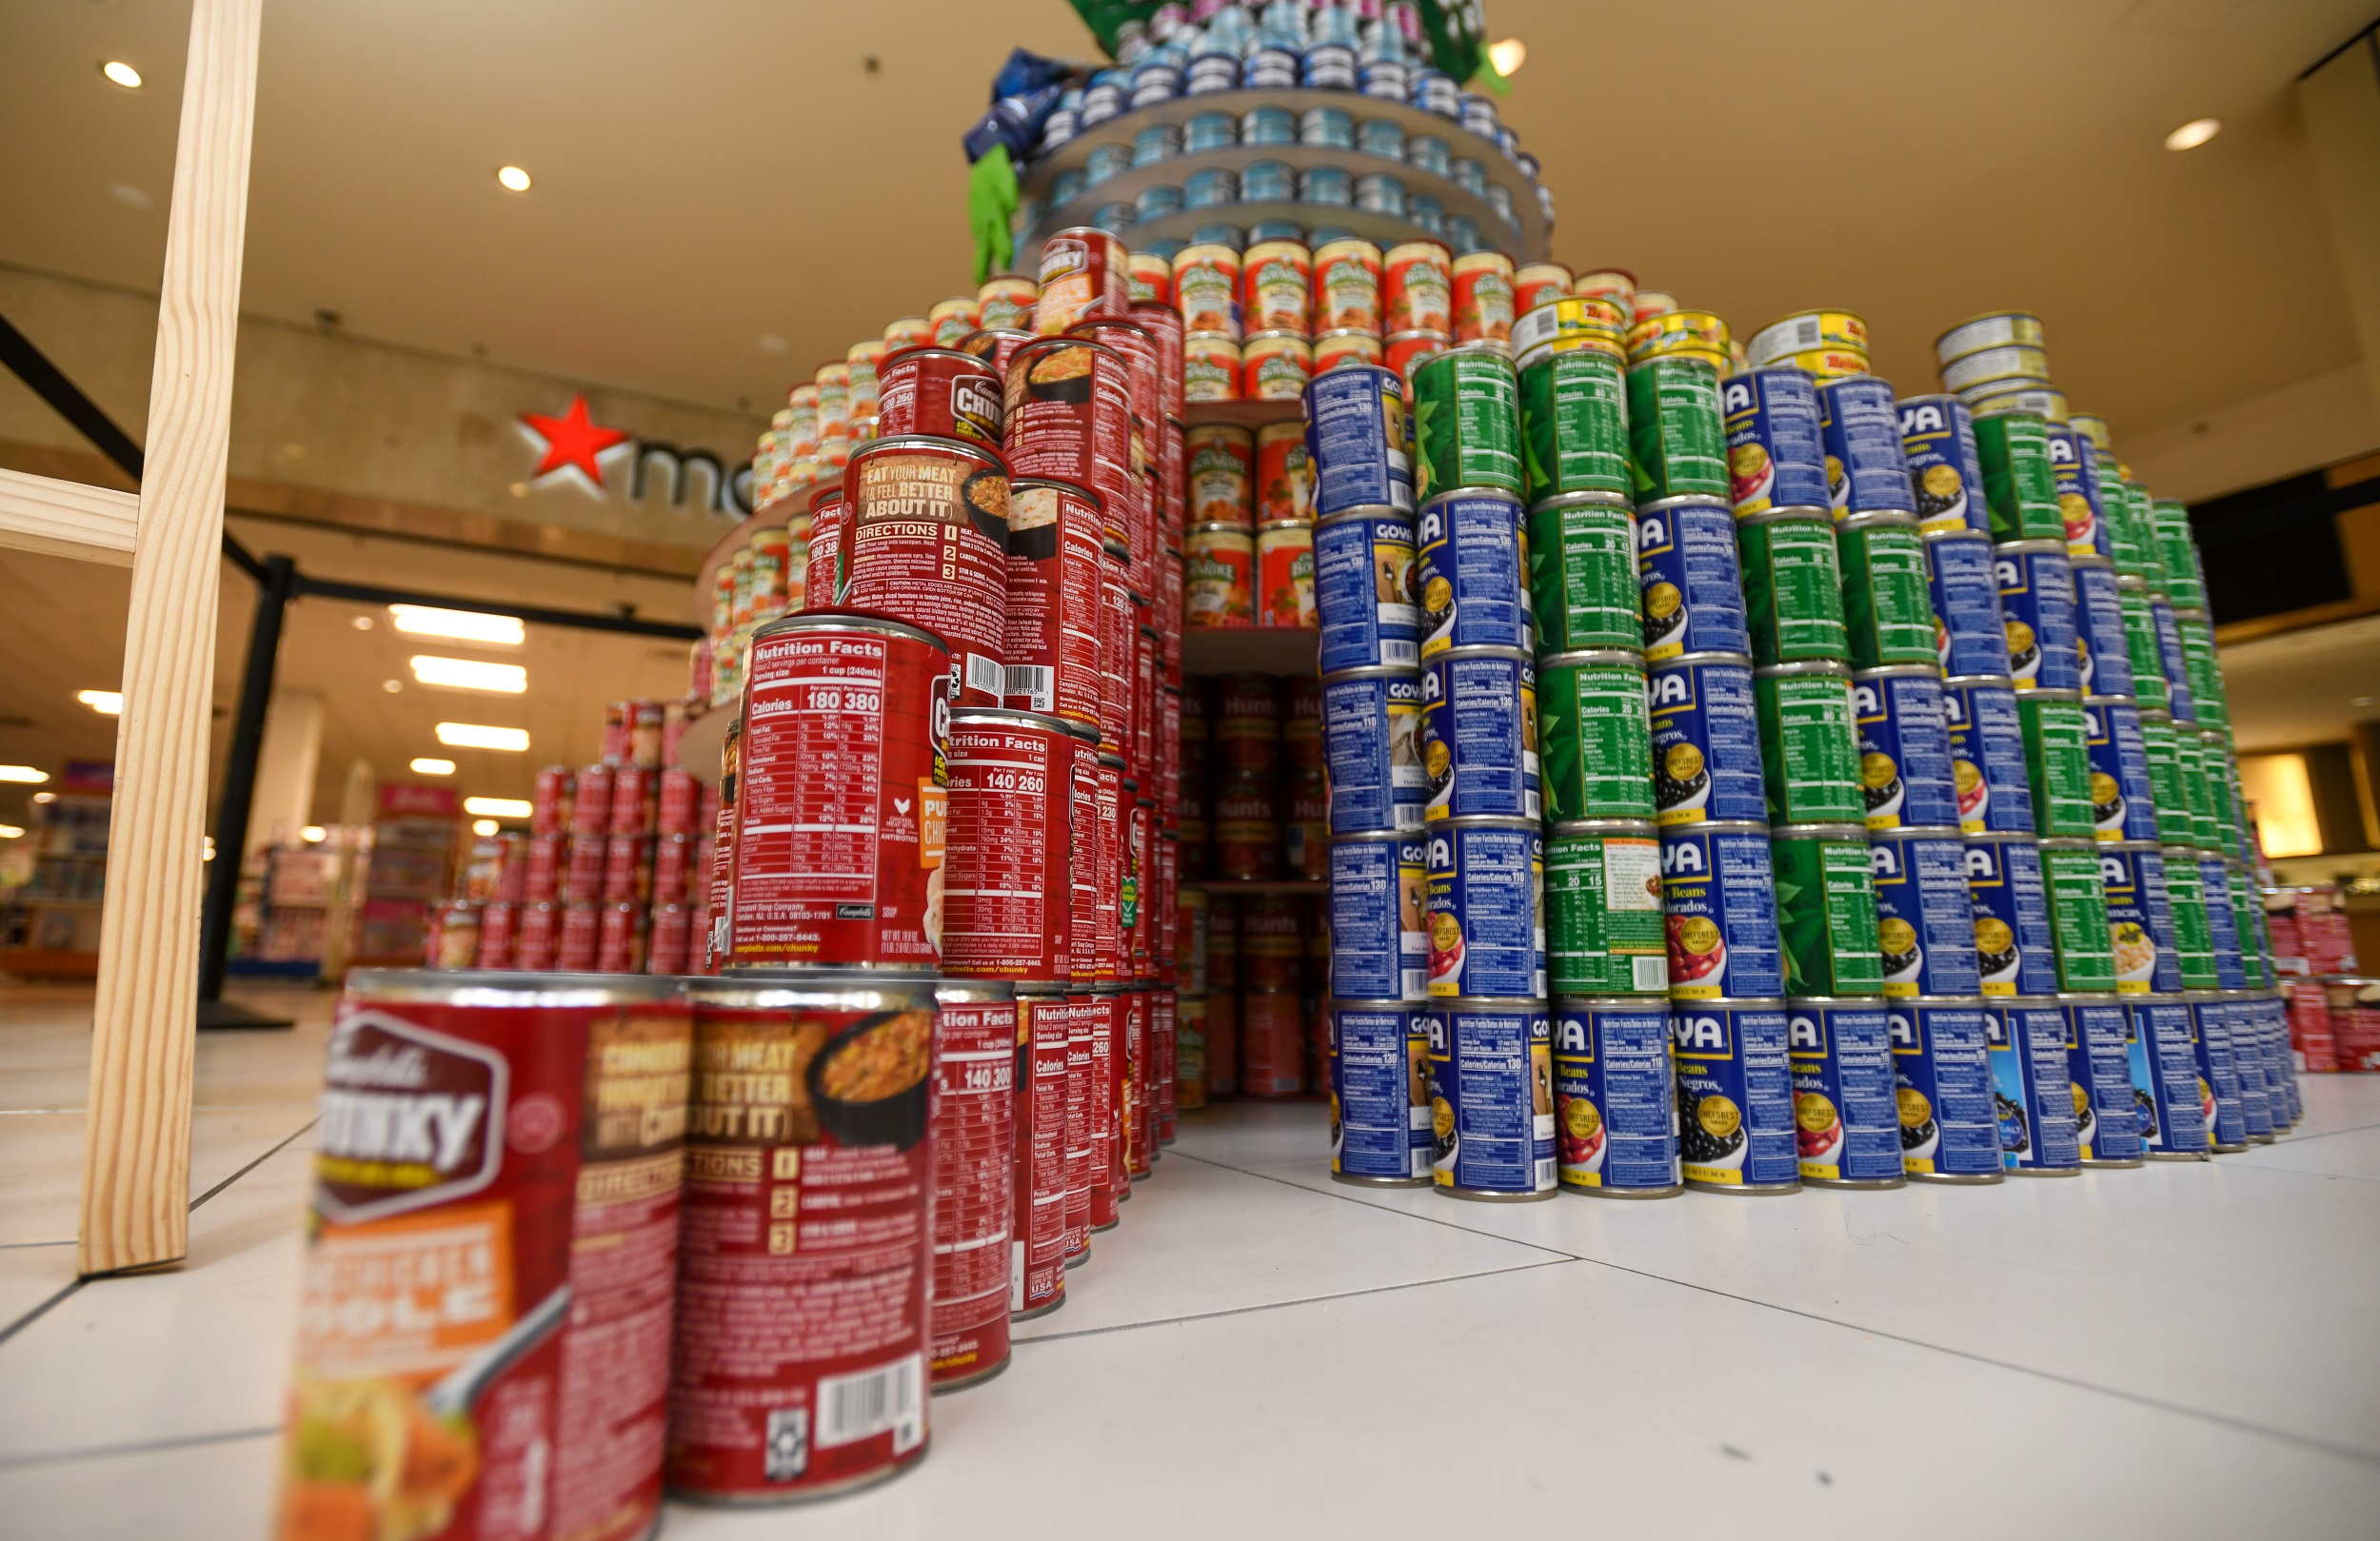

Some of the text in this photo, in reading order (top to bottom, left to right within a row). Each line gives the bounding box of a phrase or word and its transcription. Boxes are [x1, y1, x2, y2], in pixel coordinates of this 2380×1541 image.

[892, 365, 916, 377] Facts
[1557, 361, 1595, 371] Nutrition
[897, 392, 913, 404] 260
[1557, 389, 1584, 398] Calories
[1358, 402, 1372, 412] 130
[866, 465, 956, 485] EAT YOUR MEAT
[877, 483, 953, 500] FEEL BETTER
[865, 500, 953, 520] ABOUT IT)
[1564, 510, 1628, 521] Nutrition Facts
[856, 525, 938, 541] DIRECTIONS
[1377, 524, 1413, 542] GOYA
[1772, 525, 1812, 534] Nutrition
[1500, 535, 1512, 545] 130
[1565, 541, 1593, 550] Calories
[1605, 539, 1616, 548] 20
[1064, 541, 1094, 559] Calories
[1351, 557, 1364, 567] 130
[1774, 556, 1802, 564] Calories
[756, 641, 883, 662] Nutrition Facts
[772, 656, 840, 667] servings per container
[754, 672, 774, 682] Serving
[829, 667, 844, 677] cup
[847, 666, 881, 678] (240mL)
[1624, 674, 1642, 682] Facts
[1390, 682, 1425, 700] GOY
[1650, 673, 1688, 706] YA
[751, 692, 879, 716] Calories 180 380
[1499, 697, 1513, 707] 130
[1623, 704, 1632, 714] 20
[1782, 712, 1835, 723] Calories 80
[949, 735, 1045, 753] trition Facts
[987, 774, 1043, 793] 140 260
[1102, 806, 1116, 820] 230
[881, 834, 918, 843] ANTIBIOTICS
[1572, 843, 1601, 853] Facts
[1661, 842, 1702, 874] YA
[1513, 872, 1524, 882] 110
[1568, 876, 1602, 887] 20 15
[1371, 880, 1387, 891] 130
[1672, 886, 1706, 898] Beans
[1430, 897, 1452, 910] rados
[2107, 896, 2134, 905] eans
[758, 903, 772, 912] Soup
[774, 903, 803, 912] Company
[882, 907, 897, 919] SOUP
[1666, 900, 1707, 914] lorados
[789, 912, 830, 920] 08103-1701
[735, 944, 818, 954] campbells.com/chunky
[982, 1012, 1013, 1026] Facts
[1037, 1009, 1069, 1020] Nutritio
[1036, 1033, 1055, 1041] Serving
[1675, 1017, 1723, 1047] YA
[1093, 1041, 1109, 1054] 260
[1067, 1051, 1089, 1062] Calories
[1383, 1054, 1398, 1064] 130
[1652, 1057, 1663, 1068] 110
[1036, 1060, 1063, 1073] Calories
[1507, 1058, 1521, 1069] 130
[1560, 1064, 1588, 1078] Beans
[964, 1067, 1010, 1090] 140 300
[1678, 1076, 1718, 1092] Negros
[692, 1156, 761, 1175] TIONS
[1031, 1280, 1052, 1293] USA
